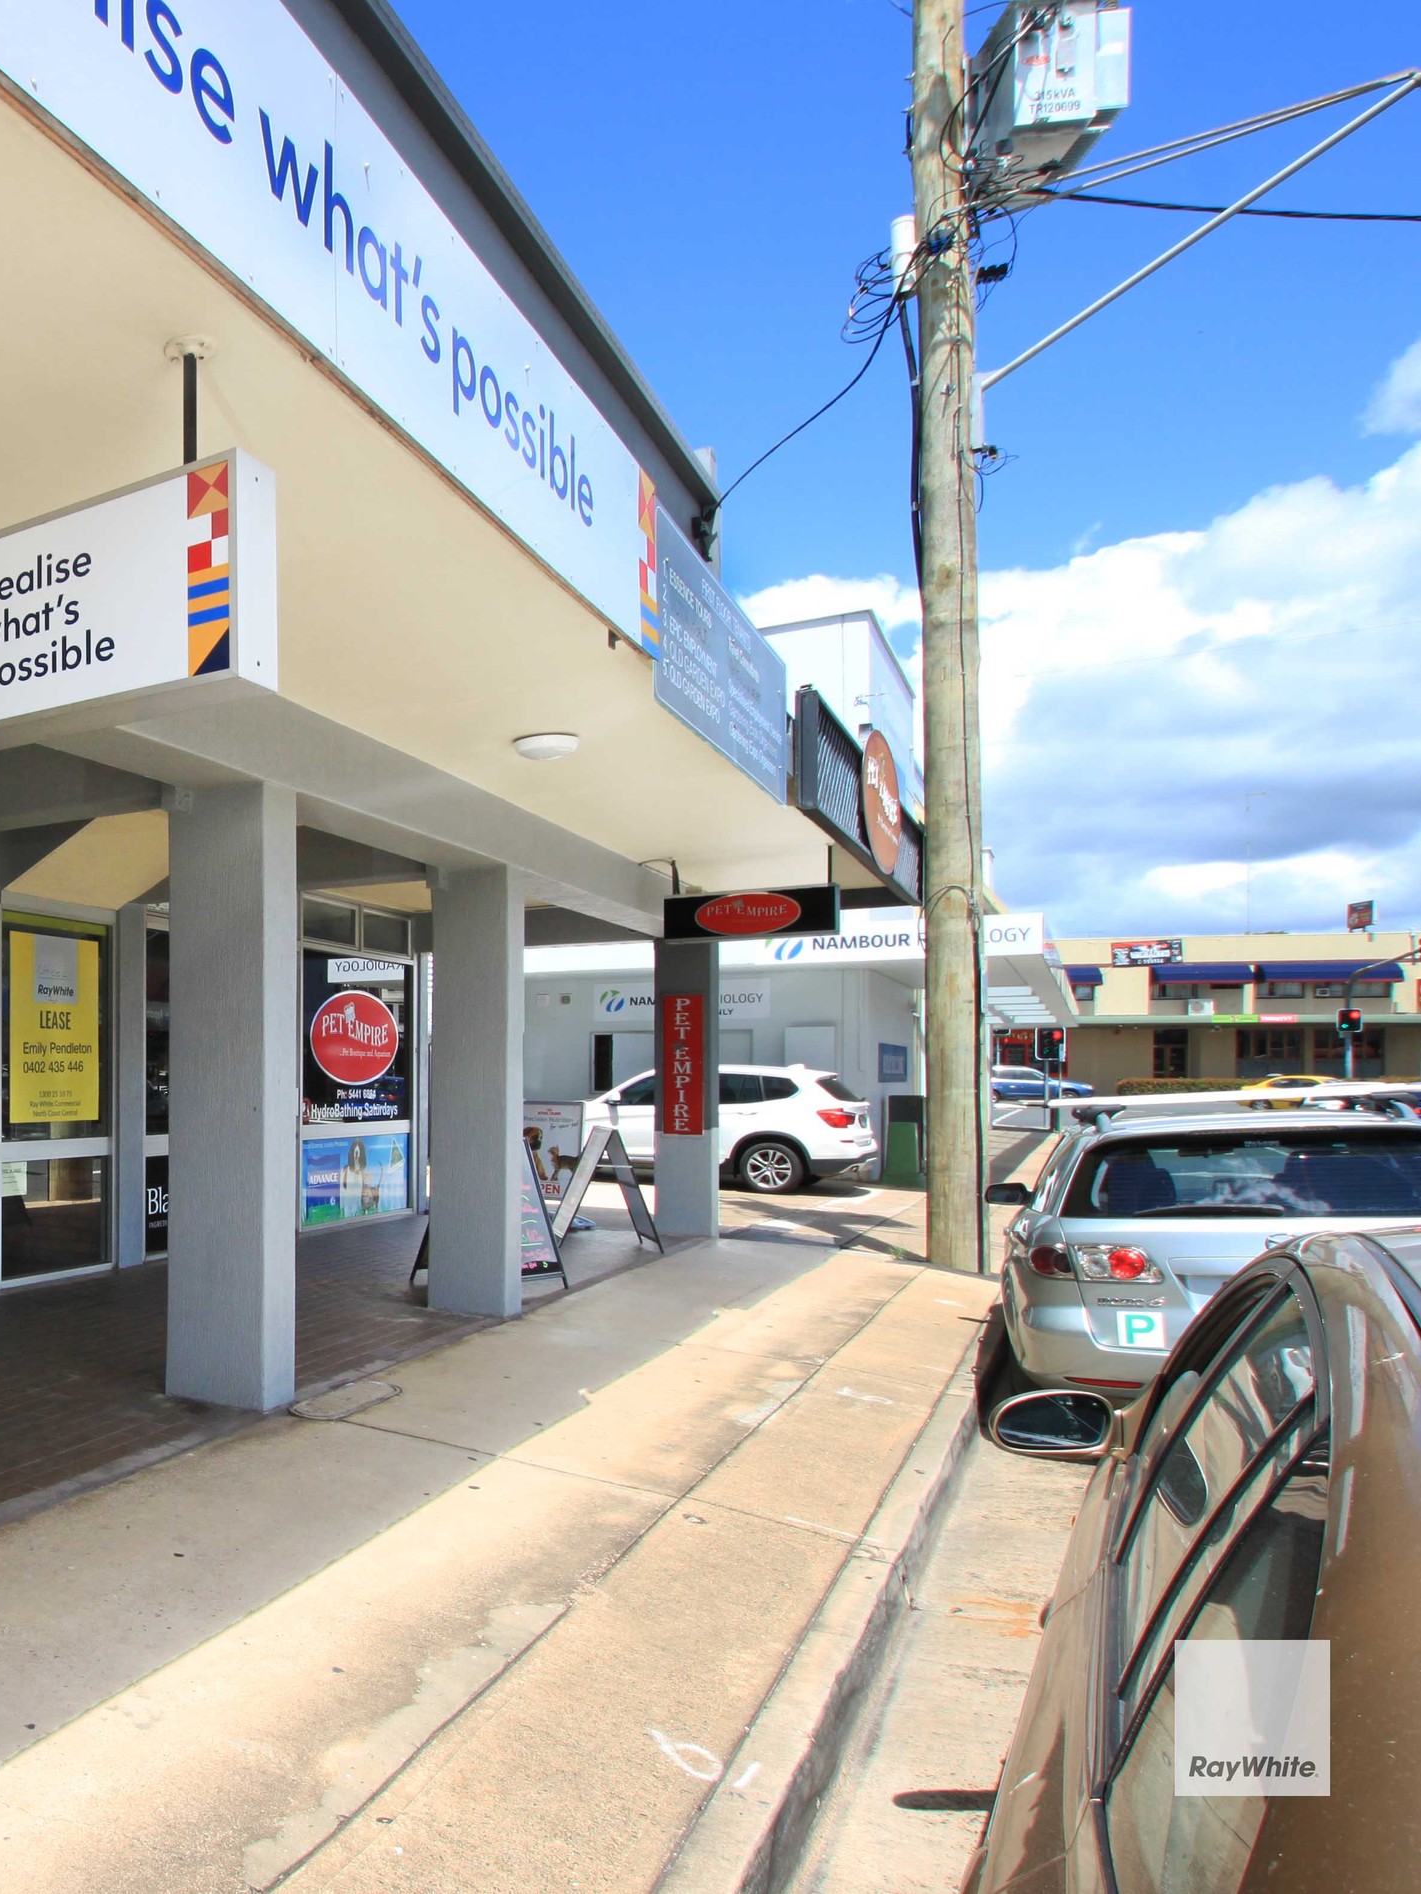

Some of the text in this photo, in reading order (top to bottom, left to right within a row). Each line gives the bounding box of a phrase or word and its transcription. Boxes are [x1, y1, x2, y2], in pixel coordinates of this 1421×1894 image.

[259, 106, 440, 364] what's
[452, 326, 594, 528] possible
[706, 903, 787, 917] PET EMPIRE
[812, 933, 910, 950] NAMBOUR
[40, 1010, 71, 1031] LEASE
[675, 998, 691, 1040] PET
[322, 1013, 389, 1047] PET EMPIRE
[23, 1042, 92, 1057] Emily Pendleton
[23, 1060, 84, 1073] 0402 435 446
[672, 1047, 692, 1131] EMPIRE
[311, 1102, 398, 1120] HydroBathing Saturdays
[309, 1172, 339, 1185] ADVANCE
[1125, 1314, 1155, 1344] P
